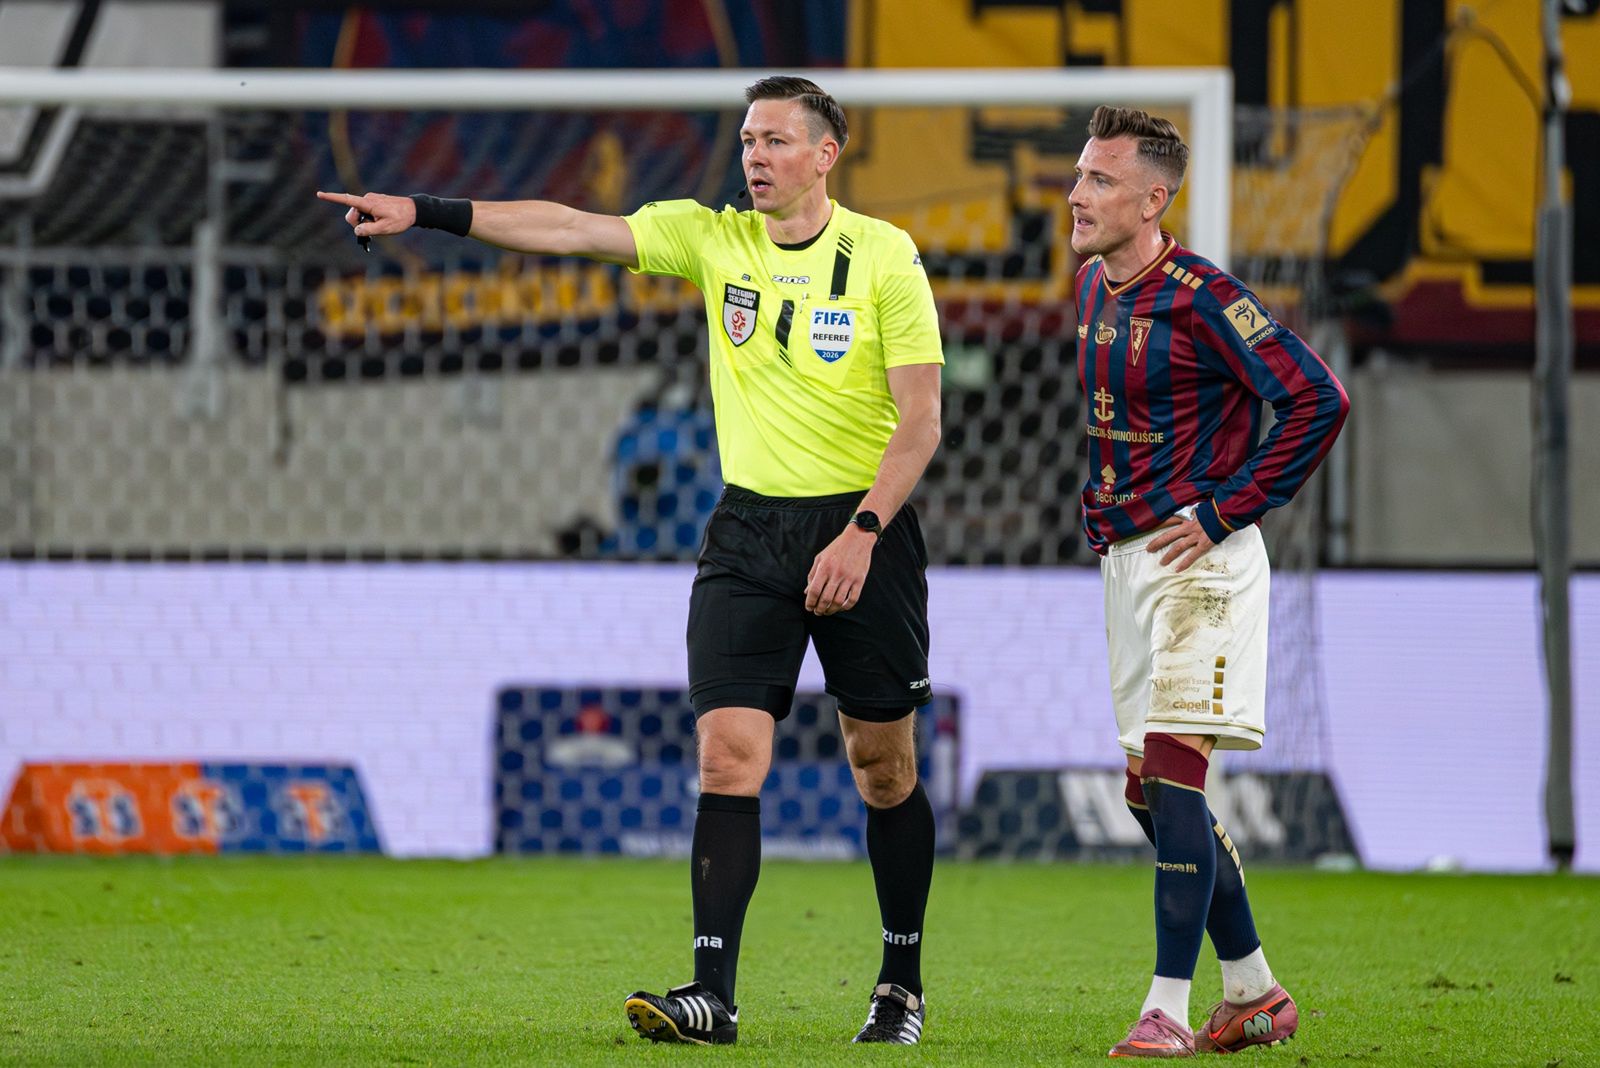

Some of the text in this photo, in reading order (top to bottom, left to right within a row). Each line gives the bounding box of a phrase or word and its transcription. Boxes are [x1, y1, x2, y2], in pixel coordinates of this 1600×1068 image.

[814, 311, 851, 326] FIFA
[812, 333, 850, 342] REFEREE
[821, 351, 839, 359] 2026
[910, 678, 930, 689] zin
[1172, 699, 1210, 712] capelli
